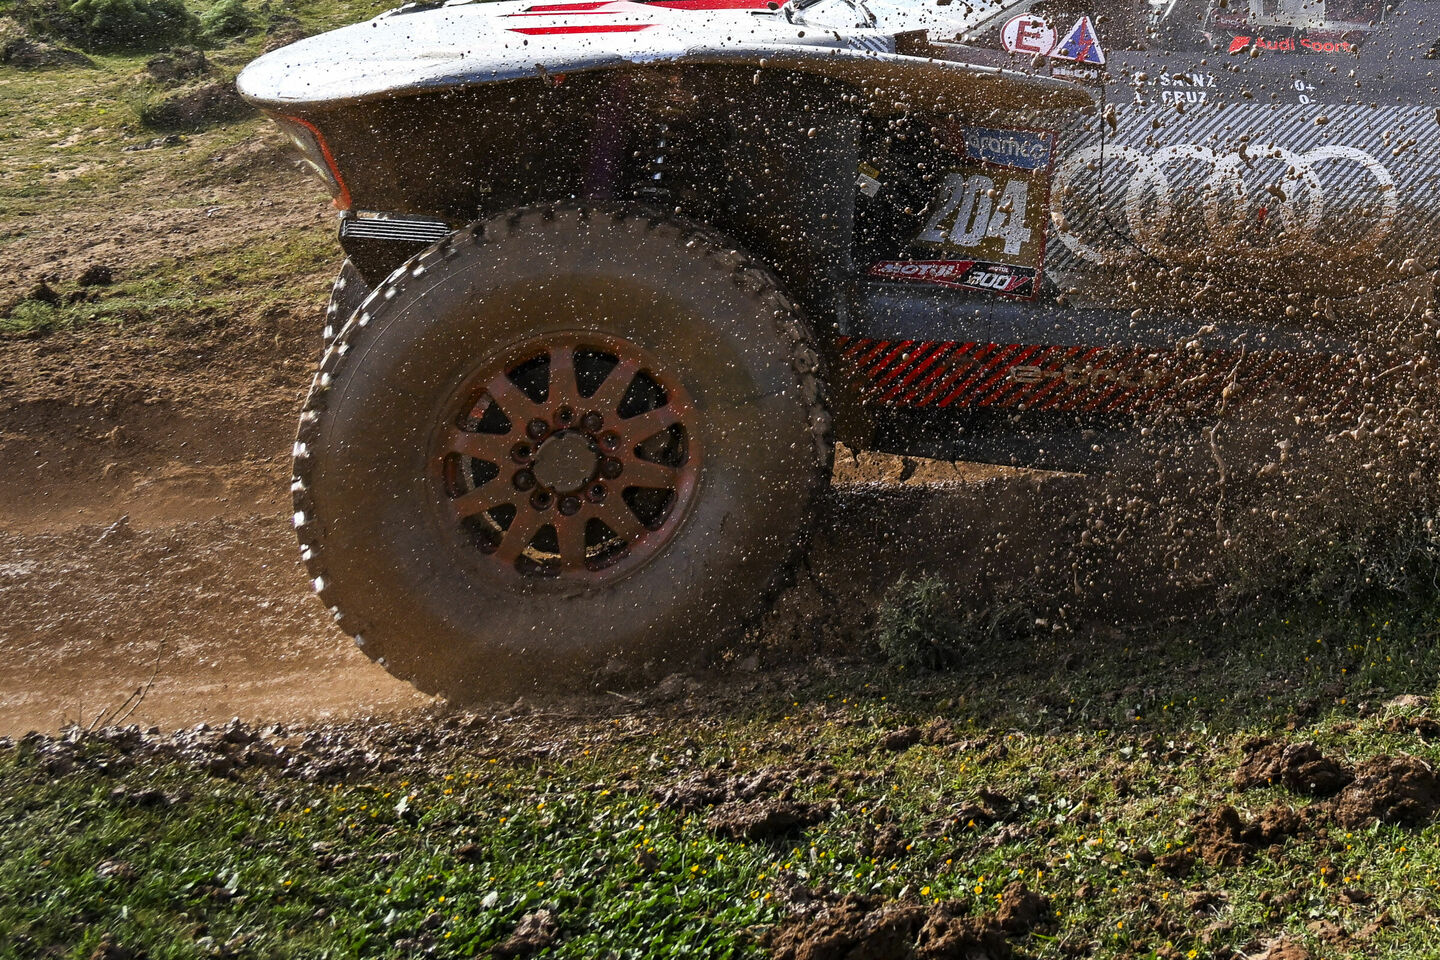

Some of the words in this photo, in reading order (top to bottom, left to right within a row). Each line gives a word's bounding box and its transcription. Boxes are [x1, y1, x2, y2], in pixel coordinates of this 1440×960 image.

[1015, 20, 1044, 52] E
[1256, 36, 1296, 51] Audi
[1161, 90, 1208, 105] CRUZ
[967, 134, 1045, 160] aramco
[915, 172, 1032, 256] 204
[881, 264, 957, 277] MOTUL
[967, 270, 1032, 292] 300V
